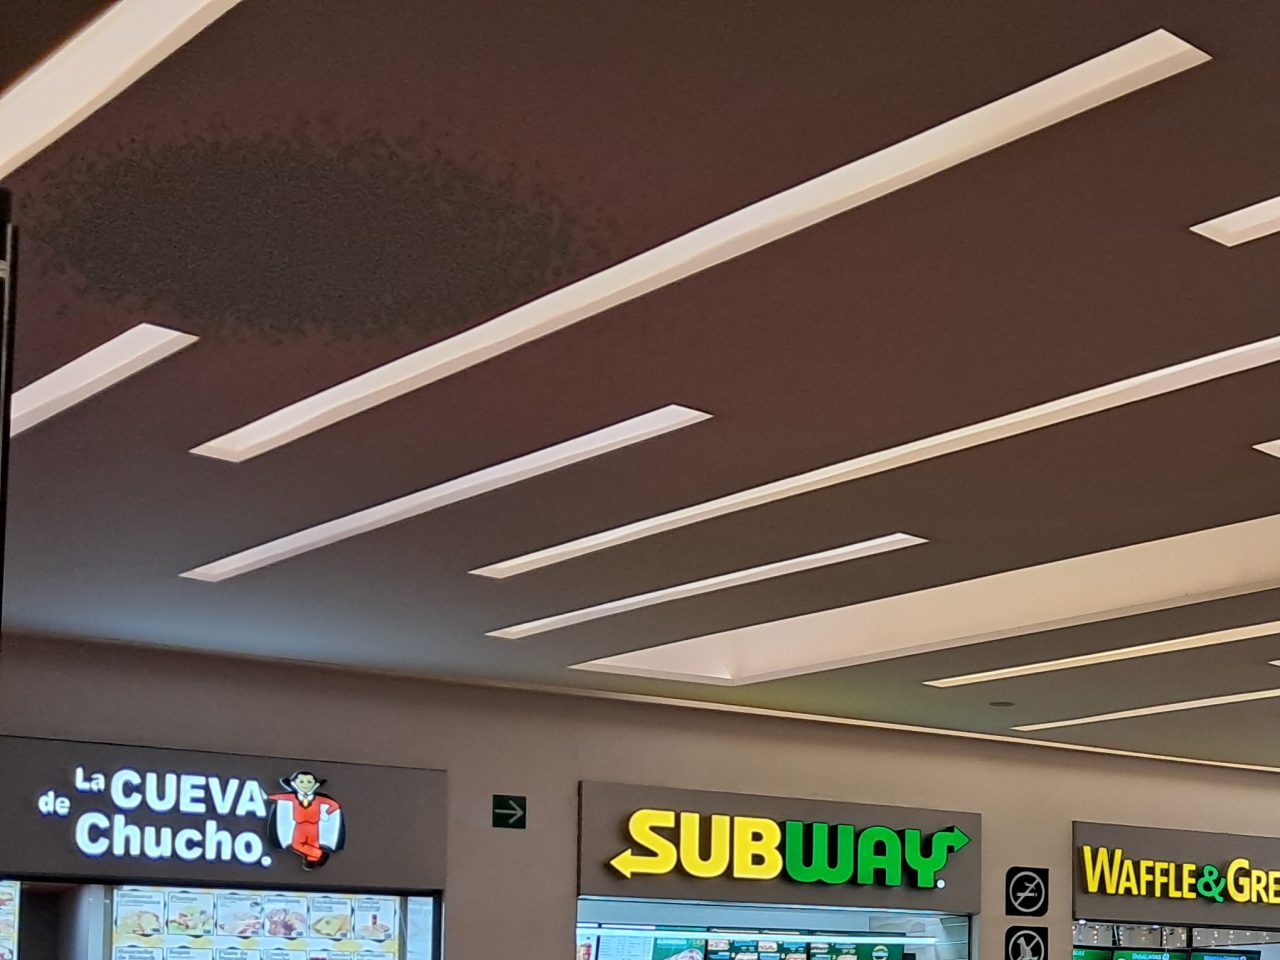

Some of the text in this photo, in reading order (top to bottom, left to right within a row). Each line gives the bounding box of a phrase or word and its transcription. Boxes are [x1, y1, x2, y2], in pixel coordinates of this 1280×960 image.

[38, 790, 71, 816] de
[75, 767, 267, 818] La CUEVA
[609, 808, 971, 889] SUBWAY
